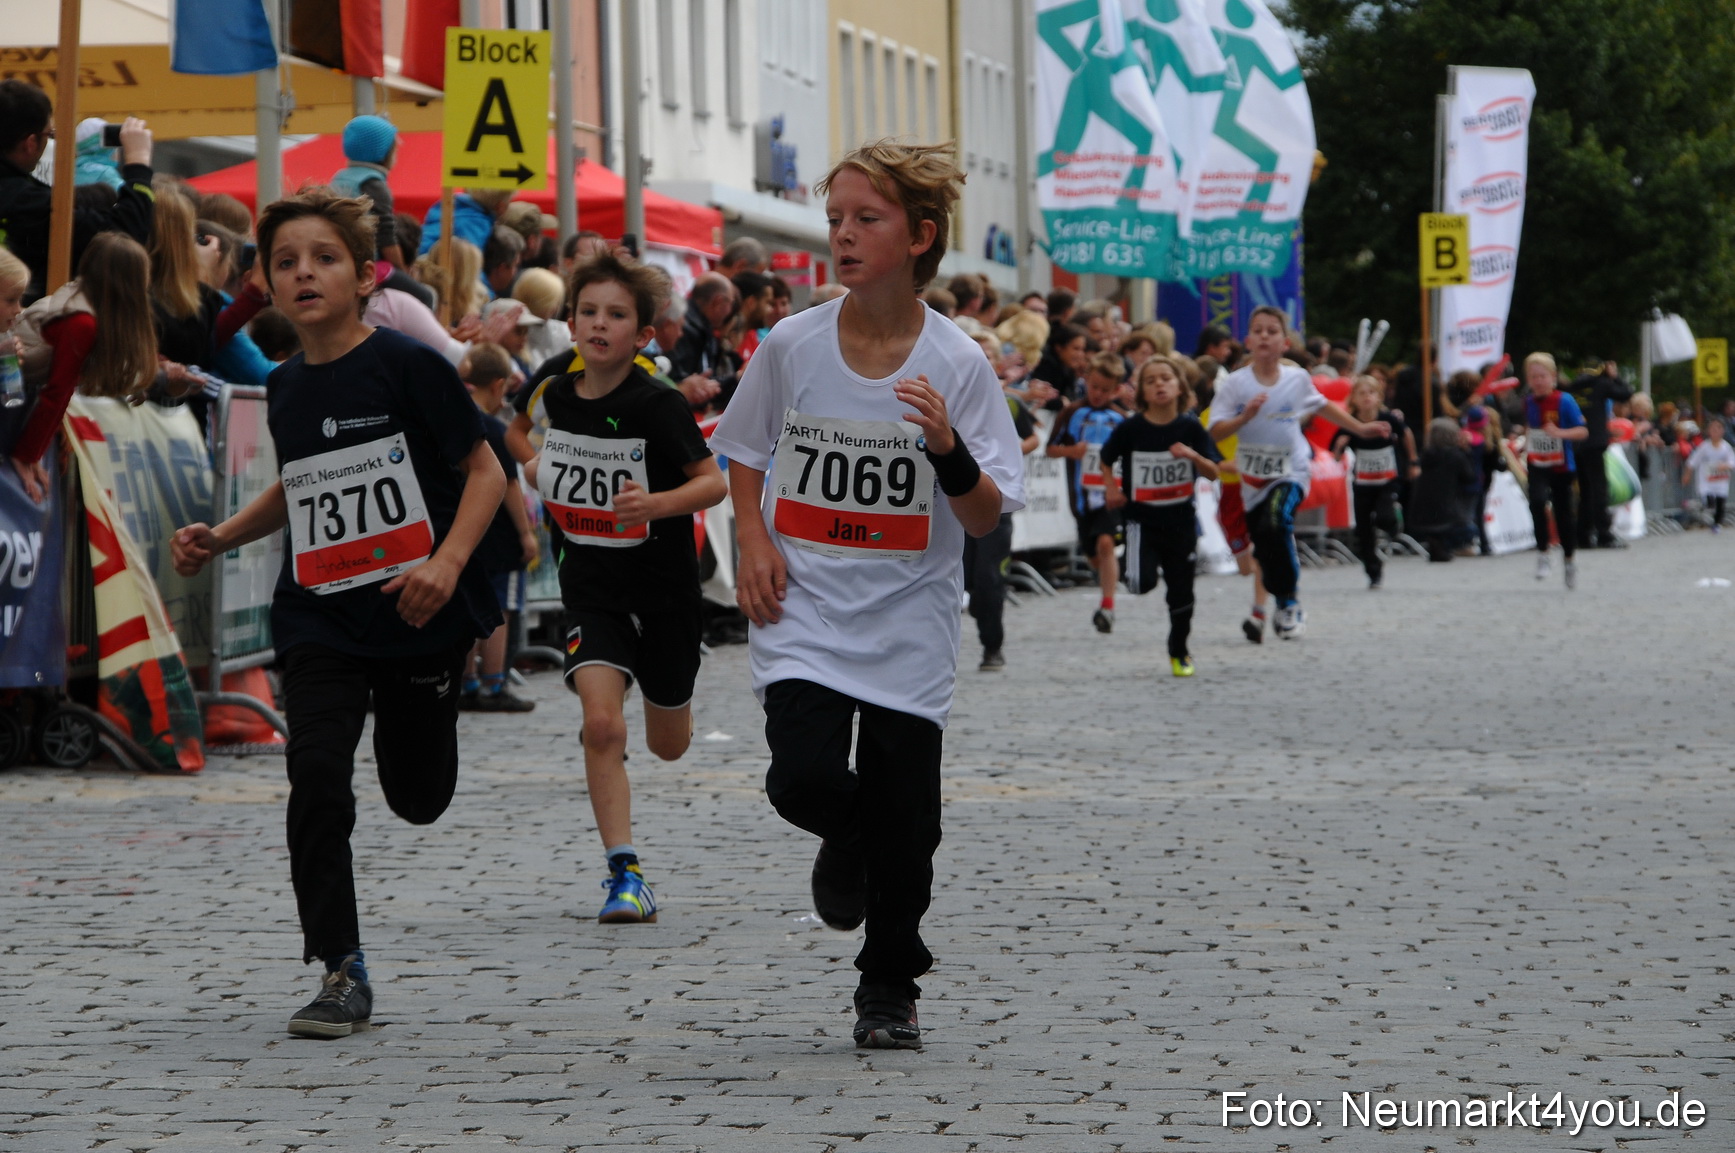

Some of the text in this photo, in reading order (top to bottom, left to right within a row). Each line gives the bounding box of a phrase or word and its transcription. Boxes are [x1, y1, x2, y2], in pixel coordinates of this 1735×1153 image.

[458, 34, 538, 63] Block
[465, 77, 524, 154] A
[1435, 236, 1458, 269] B
[1704, 352, 1720, 374] C
[784, 422, 909, 450] PARTL Neumarkt
[573, 447, 625, 461] Neumarkt
[284, 472, 318, 491] PARTL
[319, 456, 384, 483] Neumarkt
[795, 444, 916, 508] 7069
[1140, 461, 1188, 485] 7082
[781, 486, 787, 496] 6
[298, 477, 407, 546] 7370
[918, 503, 927, 512] M
[565, 512, 613, 533] Simon
[828, 517, 867, 542] Jan
